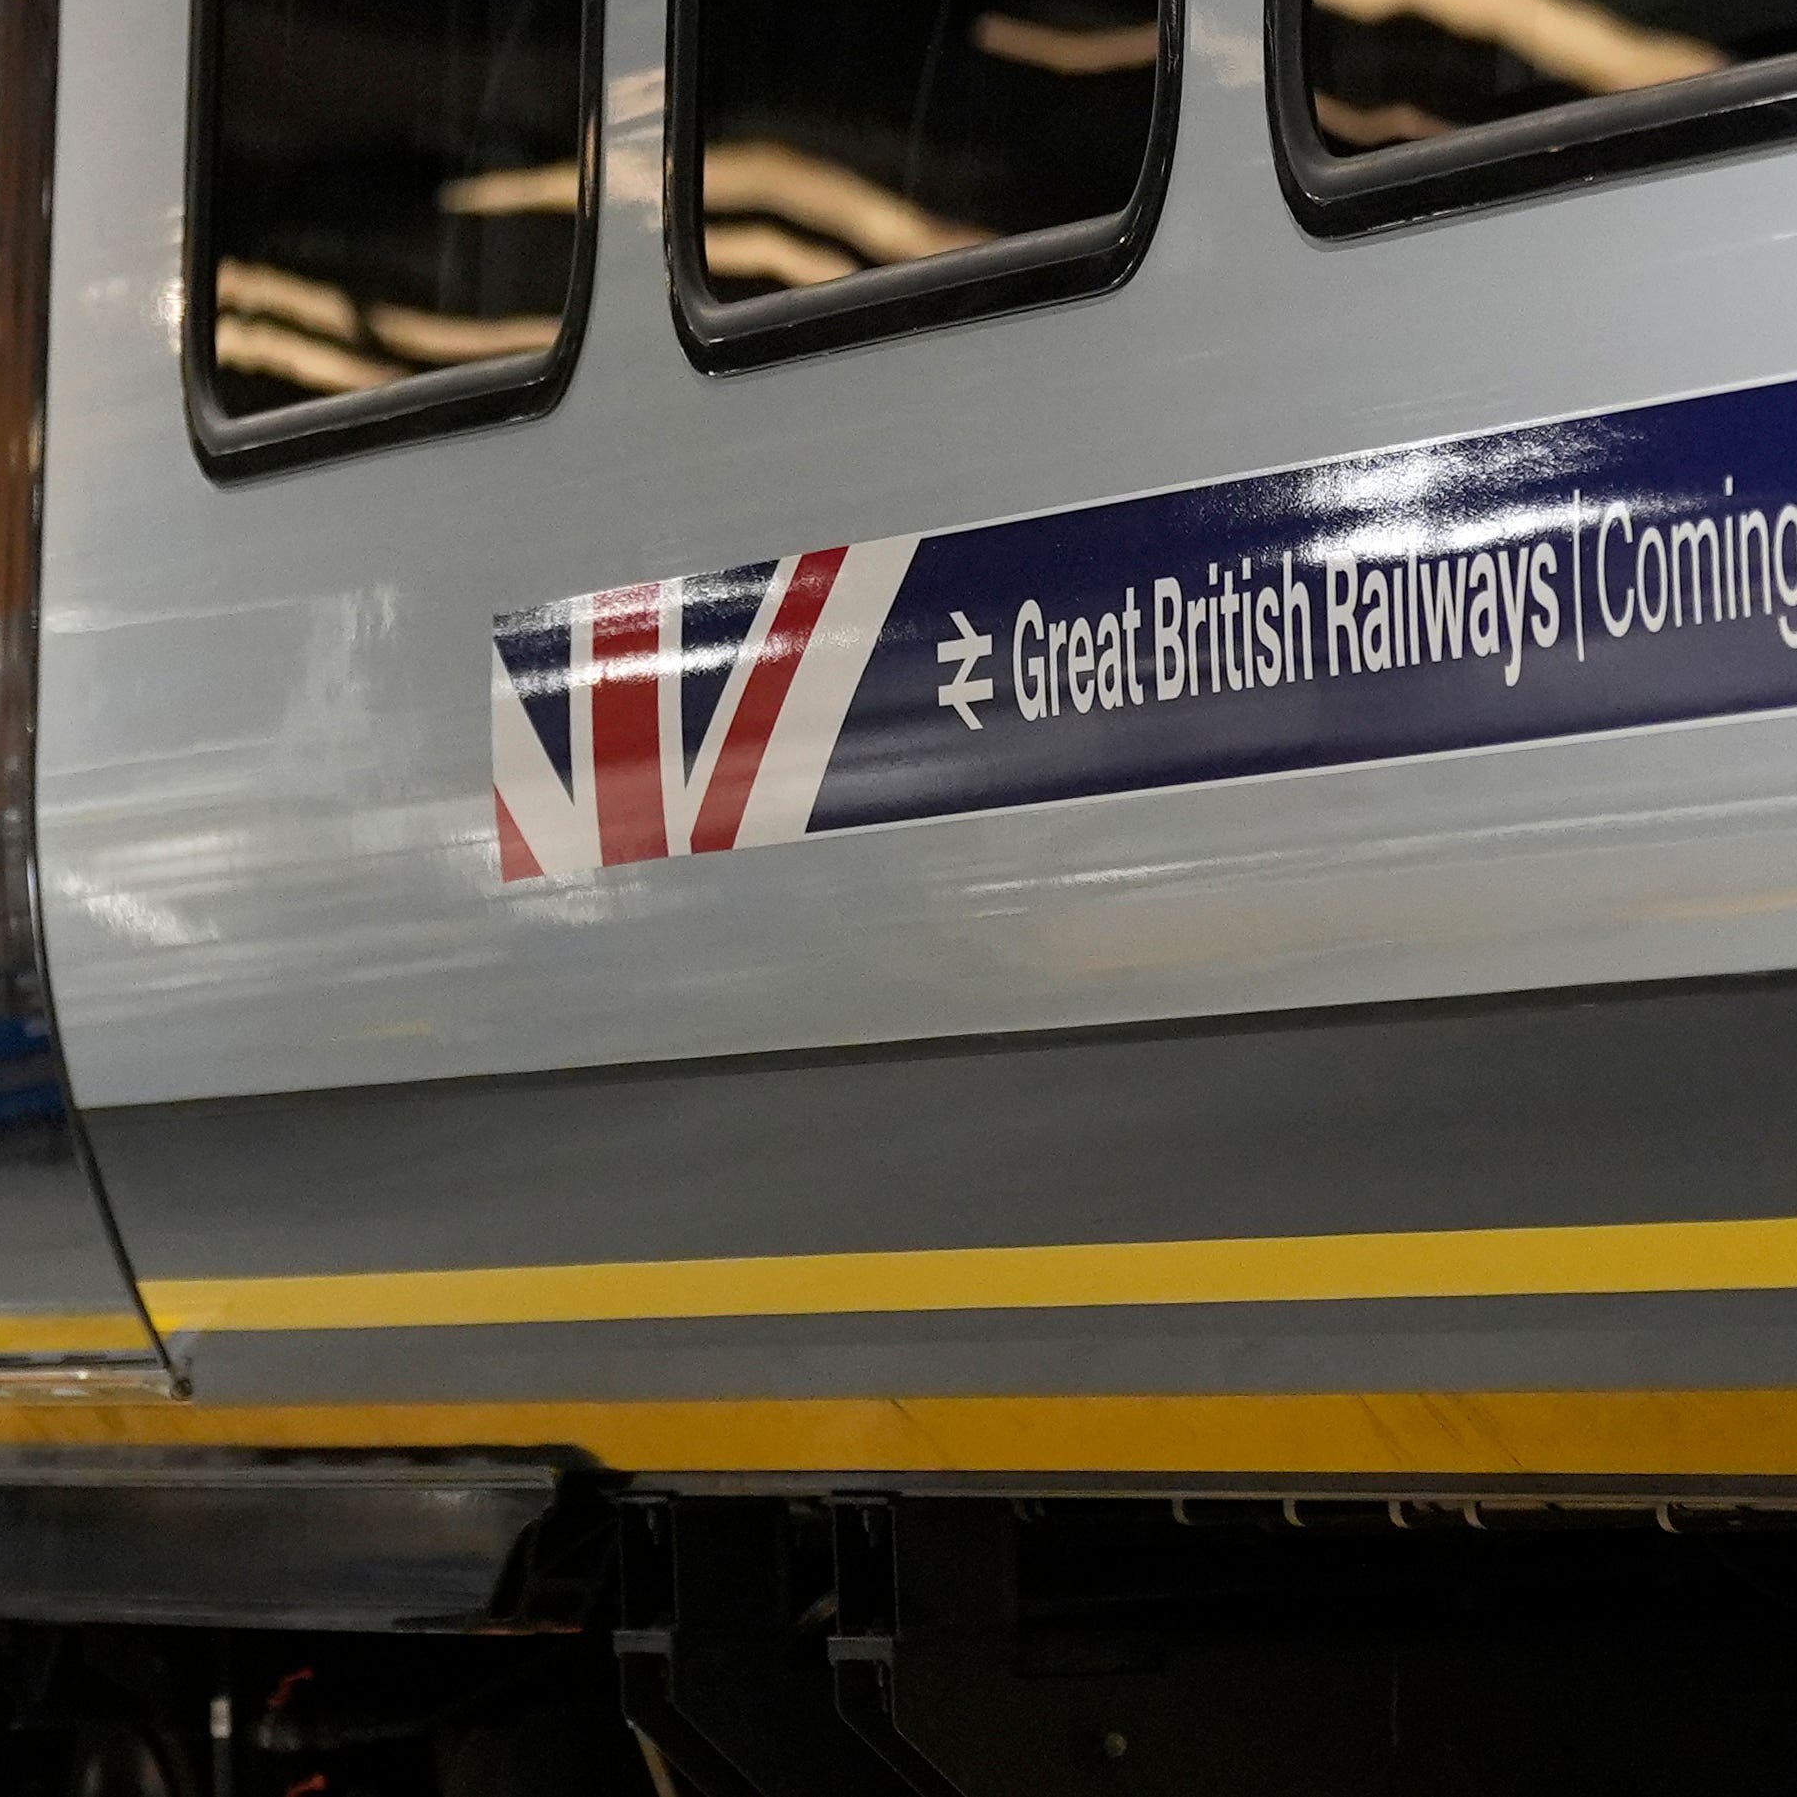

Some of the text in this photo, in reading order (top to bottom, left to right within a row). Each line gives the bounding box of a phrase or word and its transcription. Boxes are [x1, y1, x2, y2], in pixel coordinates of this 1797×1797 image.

[1012, 586, 1144, 722] Great
[1153, 550, 1314, 701] British
[1325, 530, 1561, 687] Railways
